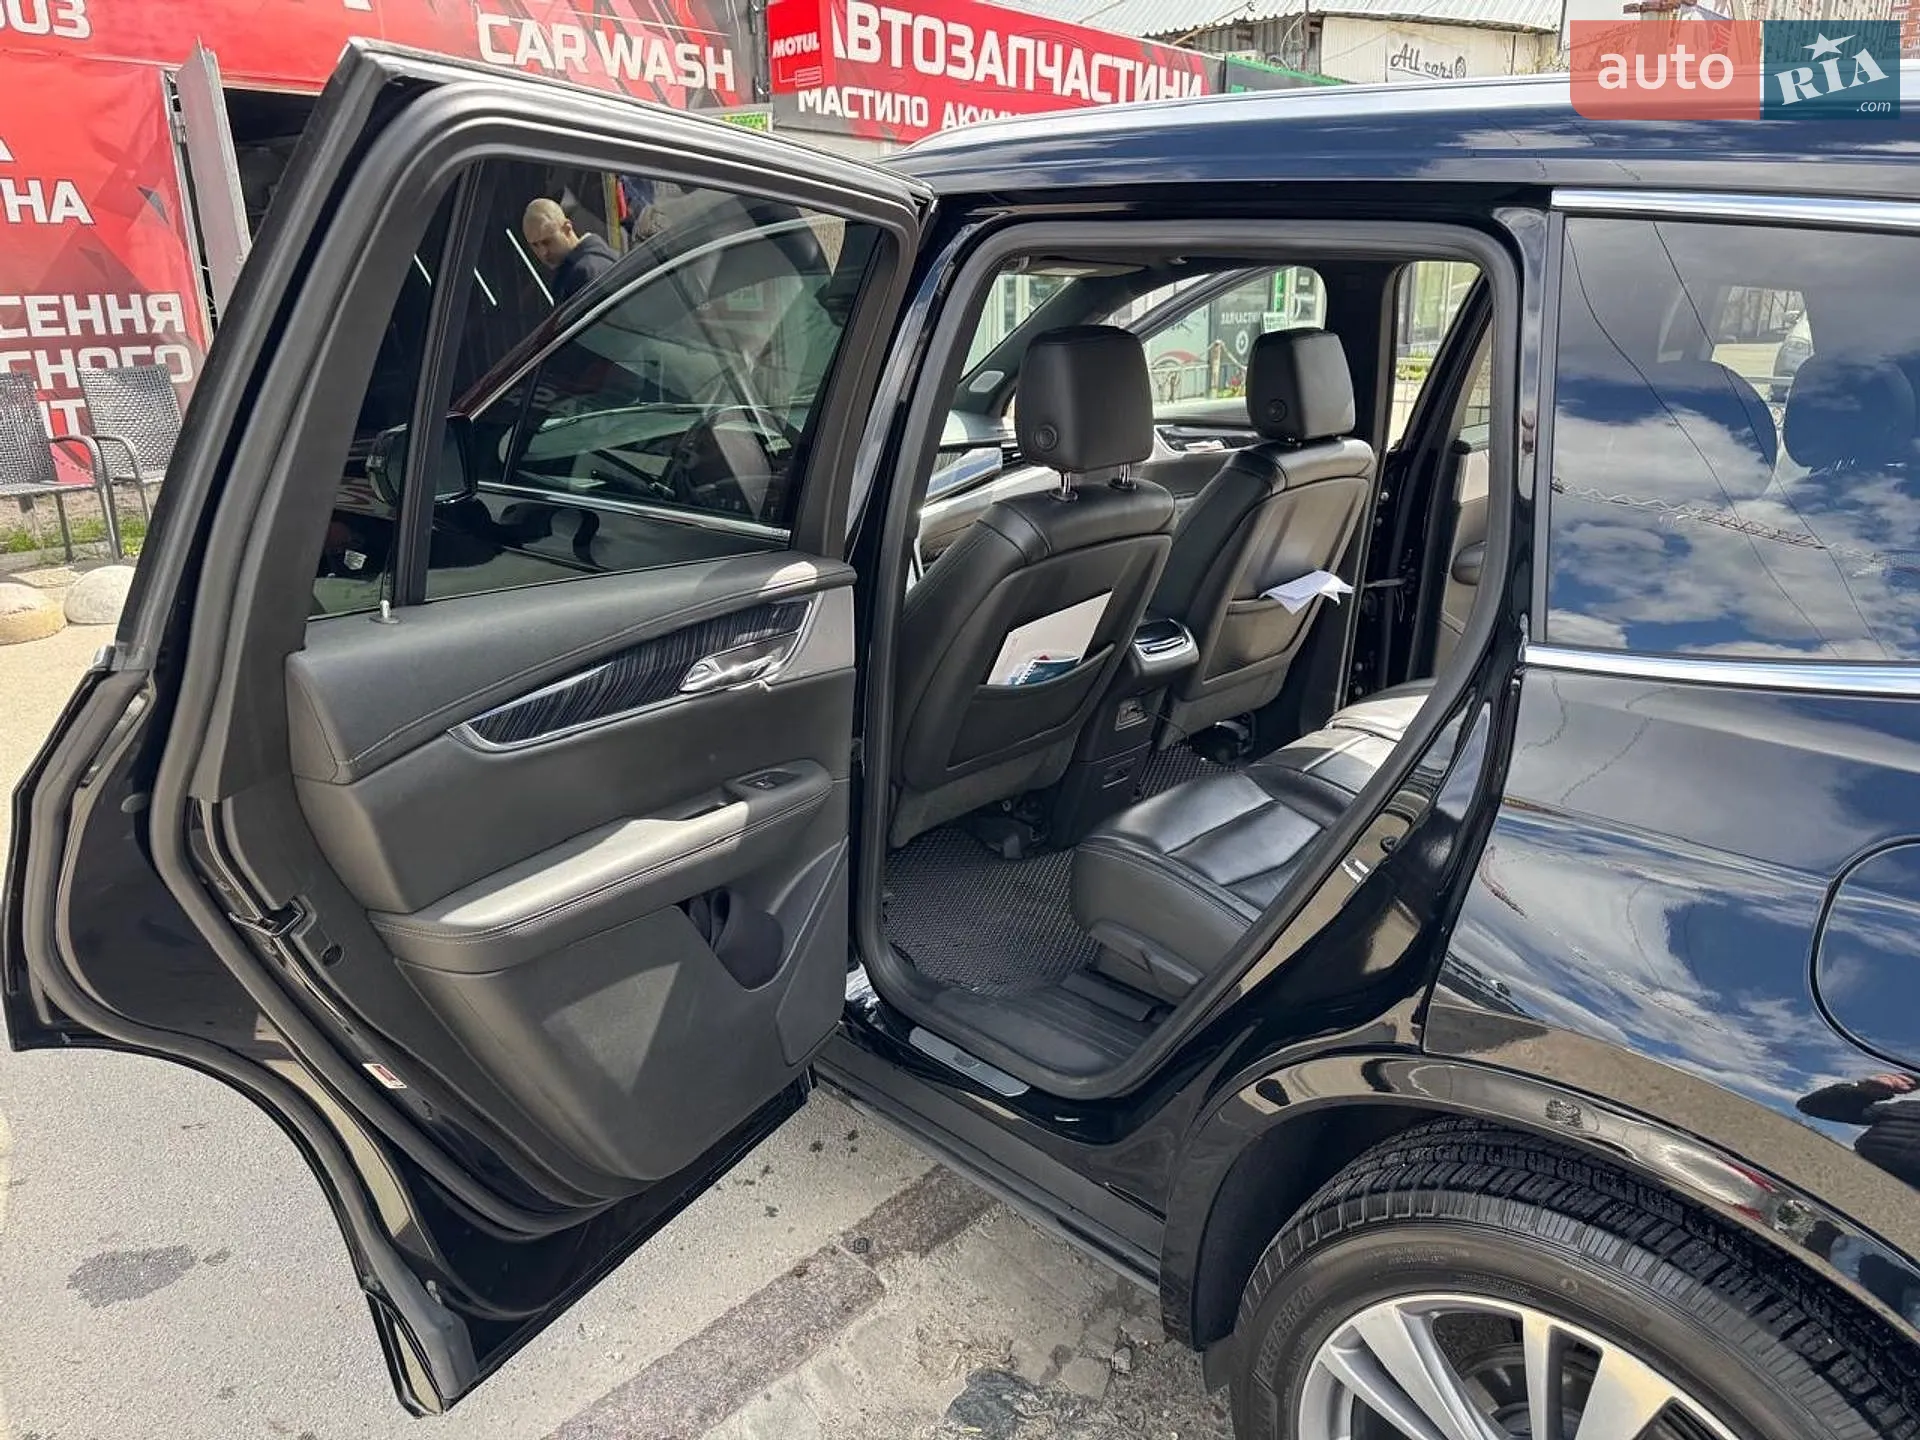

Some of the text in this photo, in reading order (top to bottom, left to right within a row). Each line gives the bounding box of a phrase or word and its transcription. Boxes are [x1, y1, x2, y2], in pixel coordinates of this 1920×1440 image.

[477, 13, 735, 92] CAR WASH
[771, 31, 820, 60] MOTUL
[1390, 42, 1420, 72] All
[798, 86, 929, 129] МАСТИЛО
